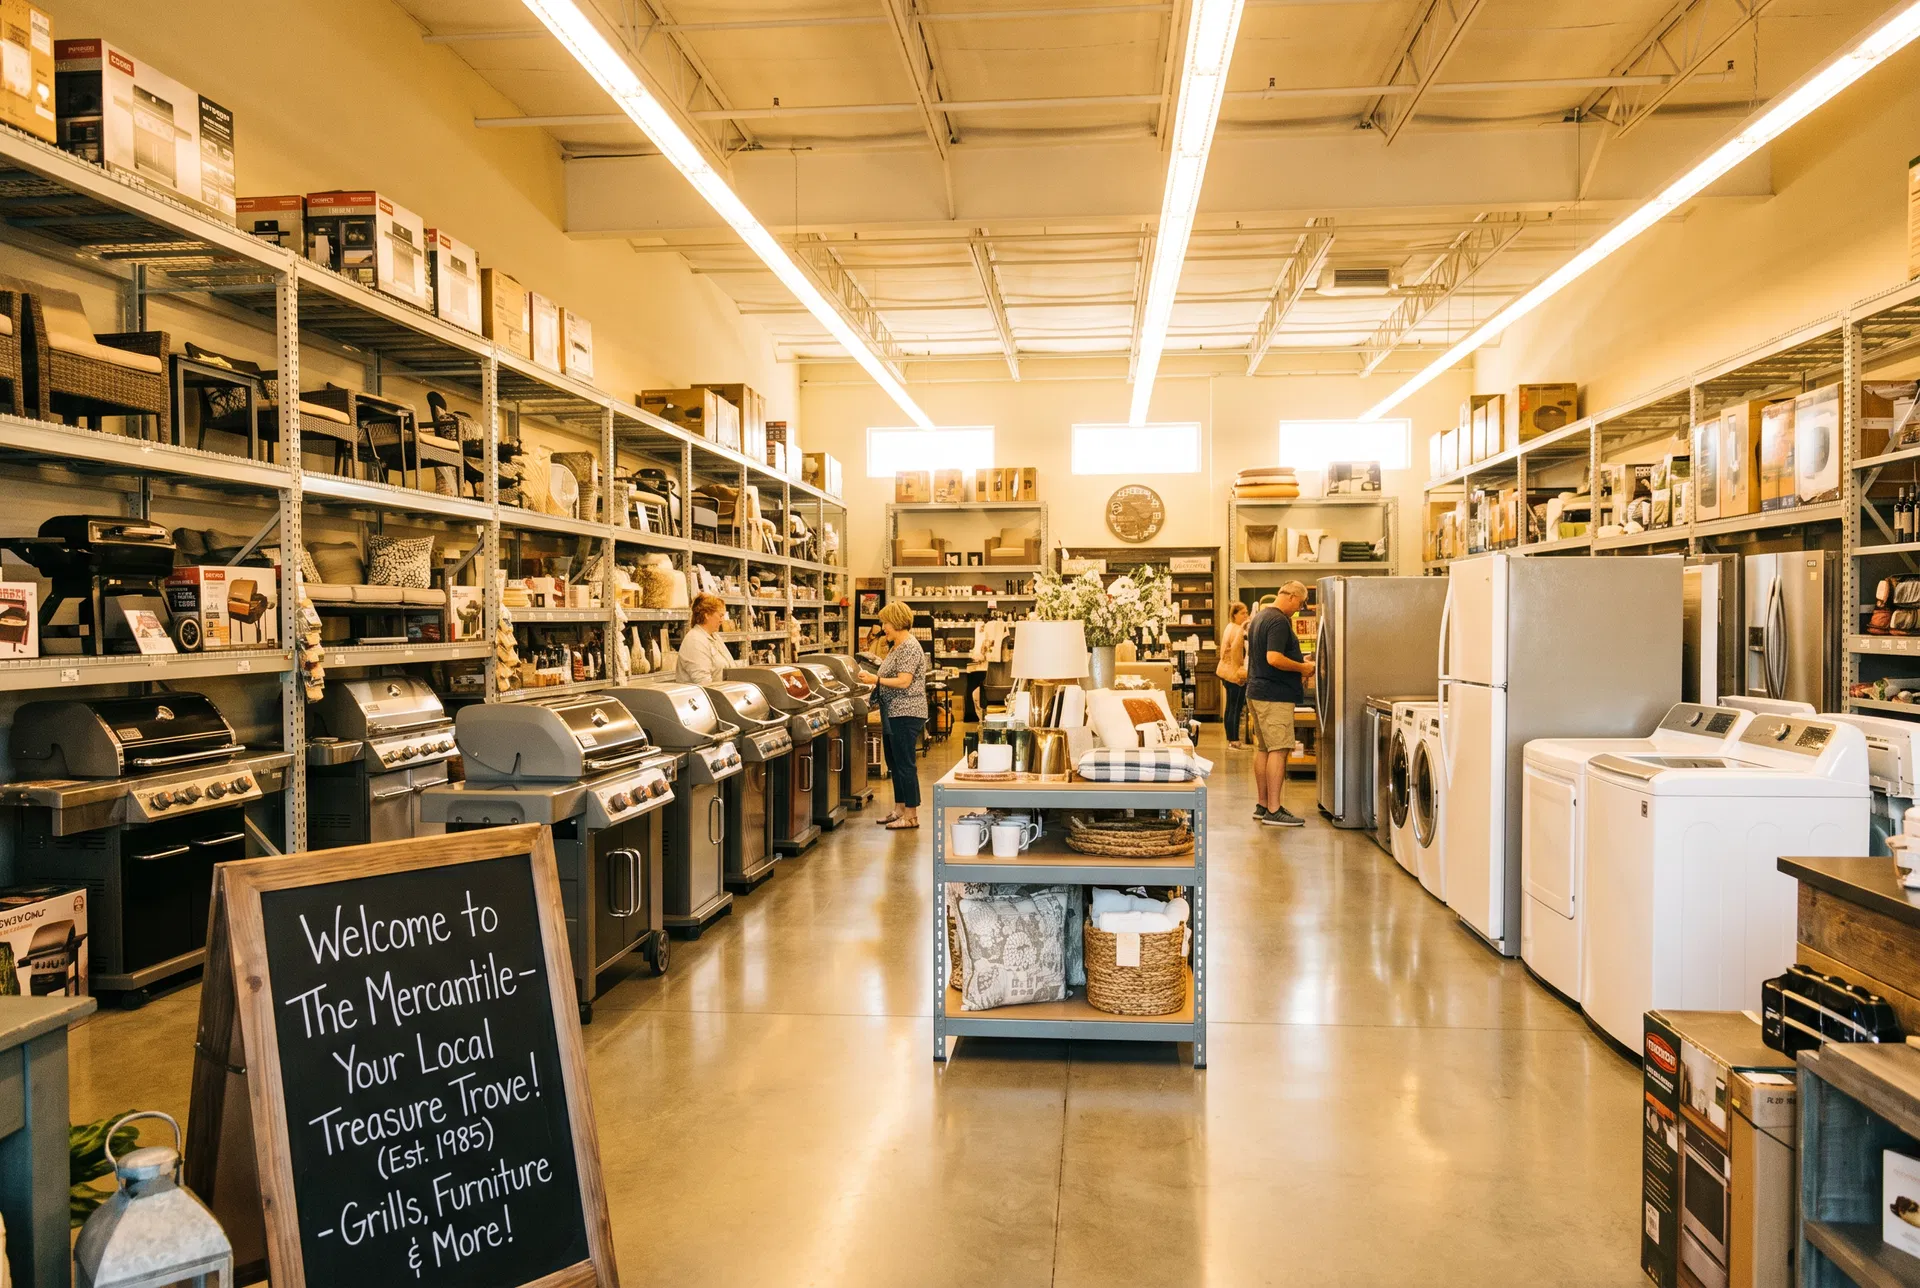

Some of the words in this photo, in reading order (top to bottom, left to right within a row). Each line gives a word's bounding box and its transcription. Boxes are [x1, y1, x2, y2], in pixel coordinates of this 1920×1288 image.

[299, 905, 452, 965] Welcome
[461, 890, 499, 938] to
[285, 983, 358, 1039] The
[333, 1043, 405, 1094] Your
[417, 1018, 494, 1075] Local
[309, 1097, 447, 1156] Treasure
[448, 1051, 541, 1117] Trove!
[377, 1140, 430, 1181] (Est.
[436, 1116, 494, 1161] 1985)
[432, 1158, 553, 1218] Furniture
[408, 1236, 423, 1279] &
[432, 1203, 514, 1268] More!
